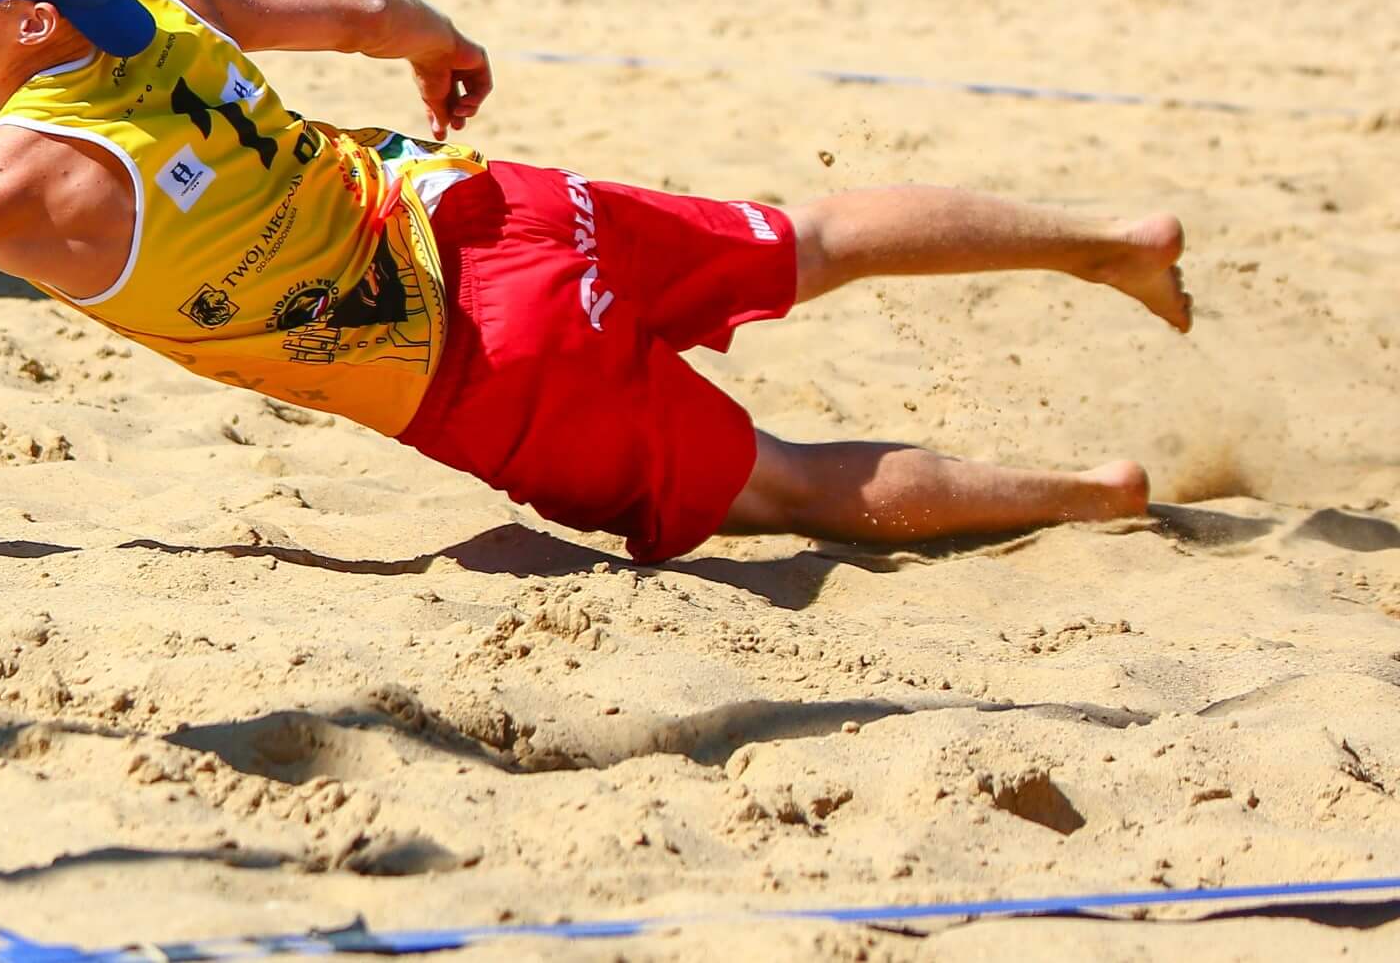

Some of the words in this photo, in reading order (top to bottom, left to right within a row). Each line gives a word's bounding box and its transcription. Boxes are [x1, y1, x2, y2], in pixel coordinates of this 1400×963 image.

[222, 242, 266, 288] TWÓJ
[264, 173, 304, 246] MECENAS
[559, 170, 599, 262] RLEN
[265, 278, 309, 330] FNDACJA
